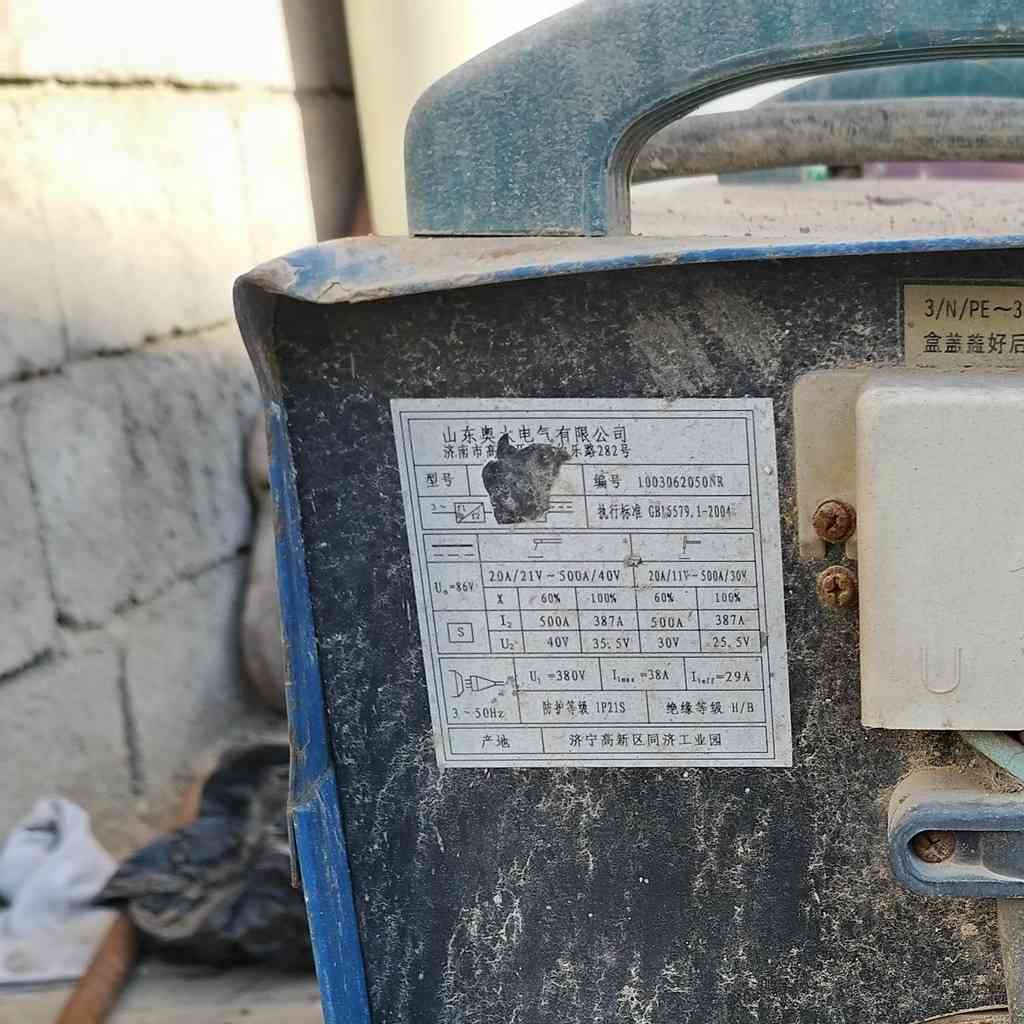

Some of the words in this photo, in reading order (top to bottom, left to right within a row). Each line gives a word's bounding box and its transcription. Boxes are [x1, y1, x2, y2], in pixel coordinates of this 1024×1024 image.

[443, 444, 631, 459] 济南市高乐路282号
[424, 471, 454, 488] 型号
[593, 471, 622, 489] 编号
[598, 503, 643, 521] 执行标准
[496, 593, 504, 605] X
[540, 592, 561, 604] 60%
[591, 592, 617, 604] 100%
[654, 591, 675, 603] 60%
[715, 591, 741, 603] 100%
[539, 615, 570, 627] 500A
[593, 614, 624, 627] 387A
[651, 616, 684, 628] 500A
[715, 614, 745, 626] 387A
[456, 626, 465, 638] S
[546, 636, 570, 648] 40V
[658, 636, 680, 649] 30V
[712, 636, 750, 649] 25.5V
[920, 647, 963, 695] U
[542, 700, 589, 716] 防护等级
[665, 700, 724, 716] 绝缘等级
[731, 701, 755, 714] H/B
[481, 733, 511, 750] 产地
[568, 732, 722, 748] 济宁高新区同济工业园
